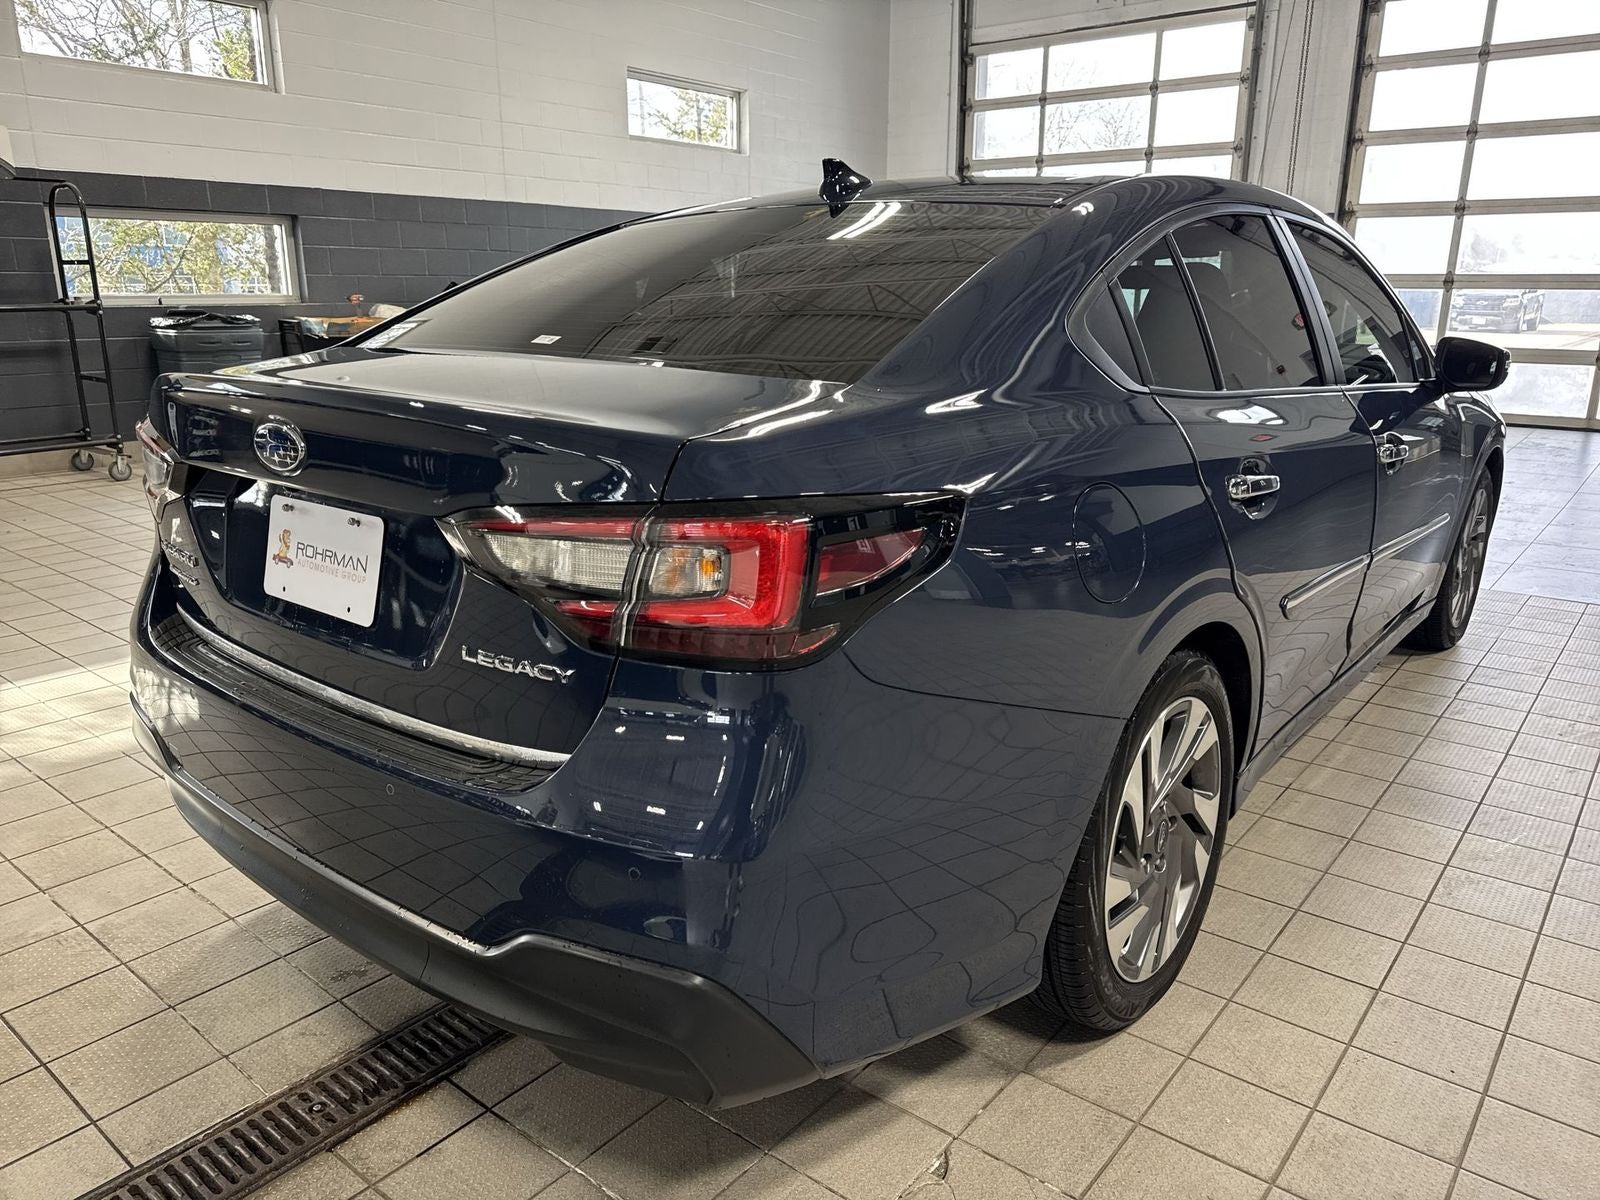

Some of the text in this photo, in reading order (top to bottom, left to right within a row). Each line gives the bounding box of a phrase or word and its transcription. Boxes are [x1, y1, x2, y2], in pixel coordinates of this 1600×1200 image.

[296, 541, 369, 573] ROHRMAN
[297, 559, 367, 584] AUTOMOTIVE GROUP
[461, 644, 576, 684] LEGACY
